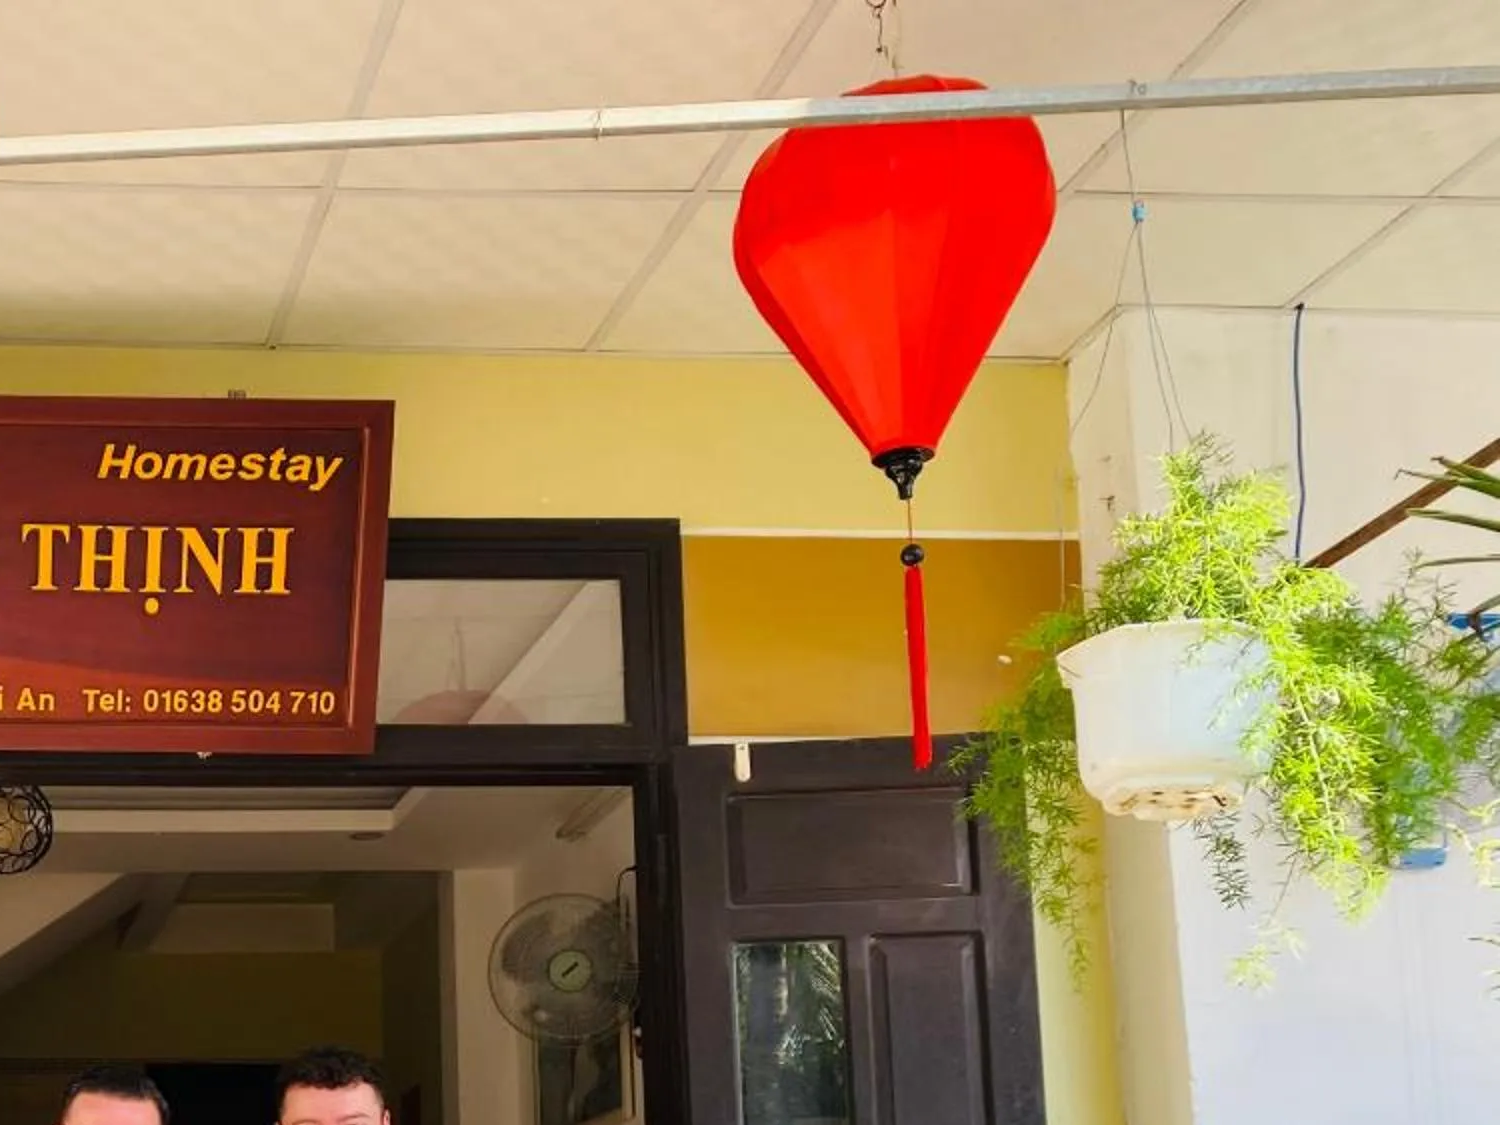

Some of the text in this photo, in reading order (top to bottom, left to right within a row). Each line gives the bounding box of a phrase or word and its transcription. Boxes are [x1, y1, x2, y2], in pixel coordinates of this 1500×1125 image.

[98, 443, 343, 491] Homestay
[22, 523, 294, 614] THỊNH
[16, 687, 55, 711] An
[82, 689, 131, 713] Tel:
[143, 689, 223, 713] 01638
[231, 689, 281, 714] 504
[290, 691, 335, 714] 710
